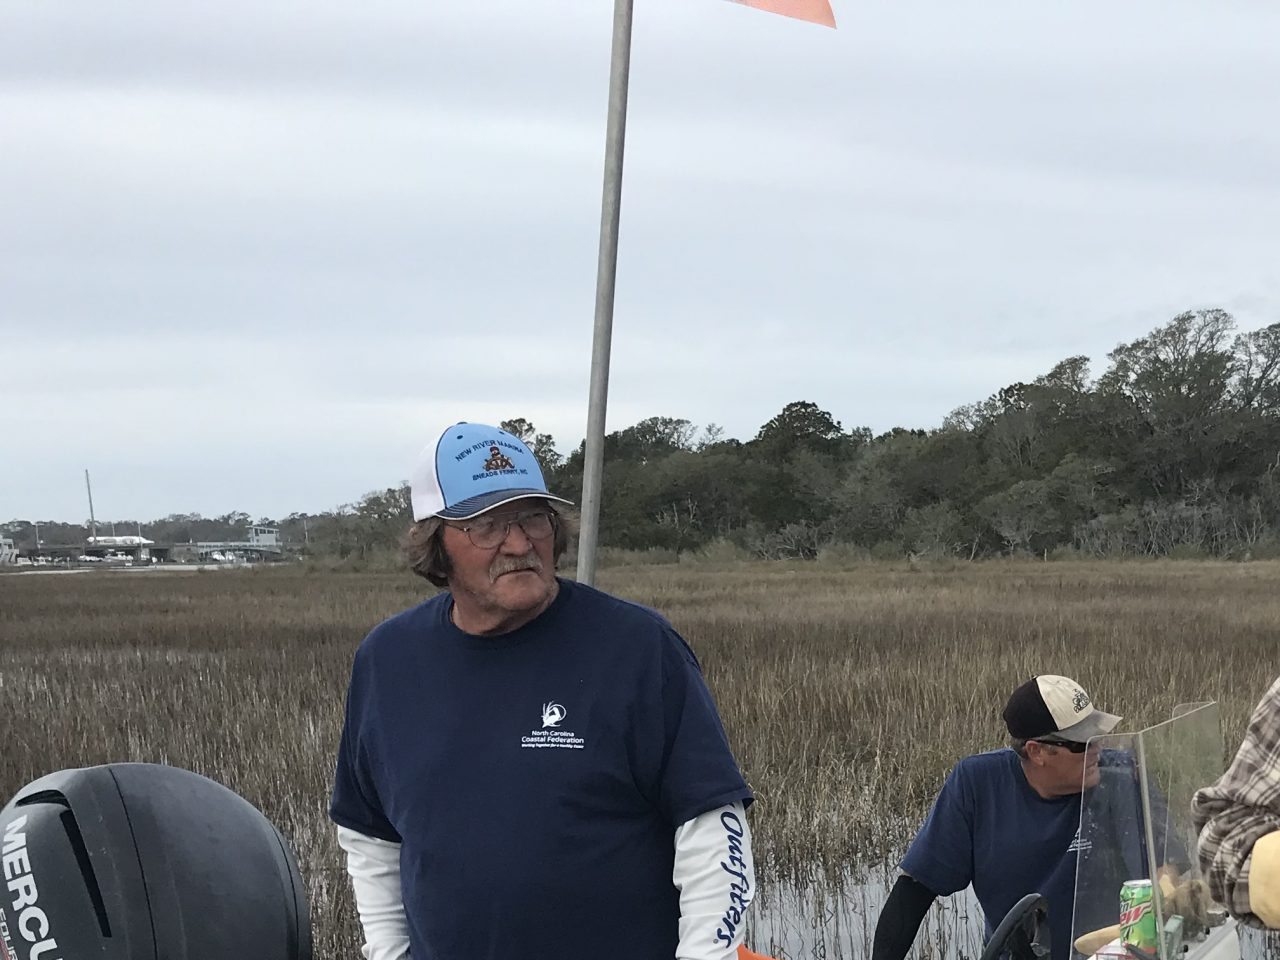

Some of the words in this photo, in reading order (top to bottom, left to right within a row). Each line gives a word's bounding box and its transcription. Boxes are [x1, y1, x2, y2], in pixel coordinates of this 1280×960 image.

[455, 448, 472, 462] NEW
[472, 440, 496, 451] RIVER
[472, 470, 498, 481] SNEADS
